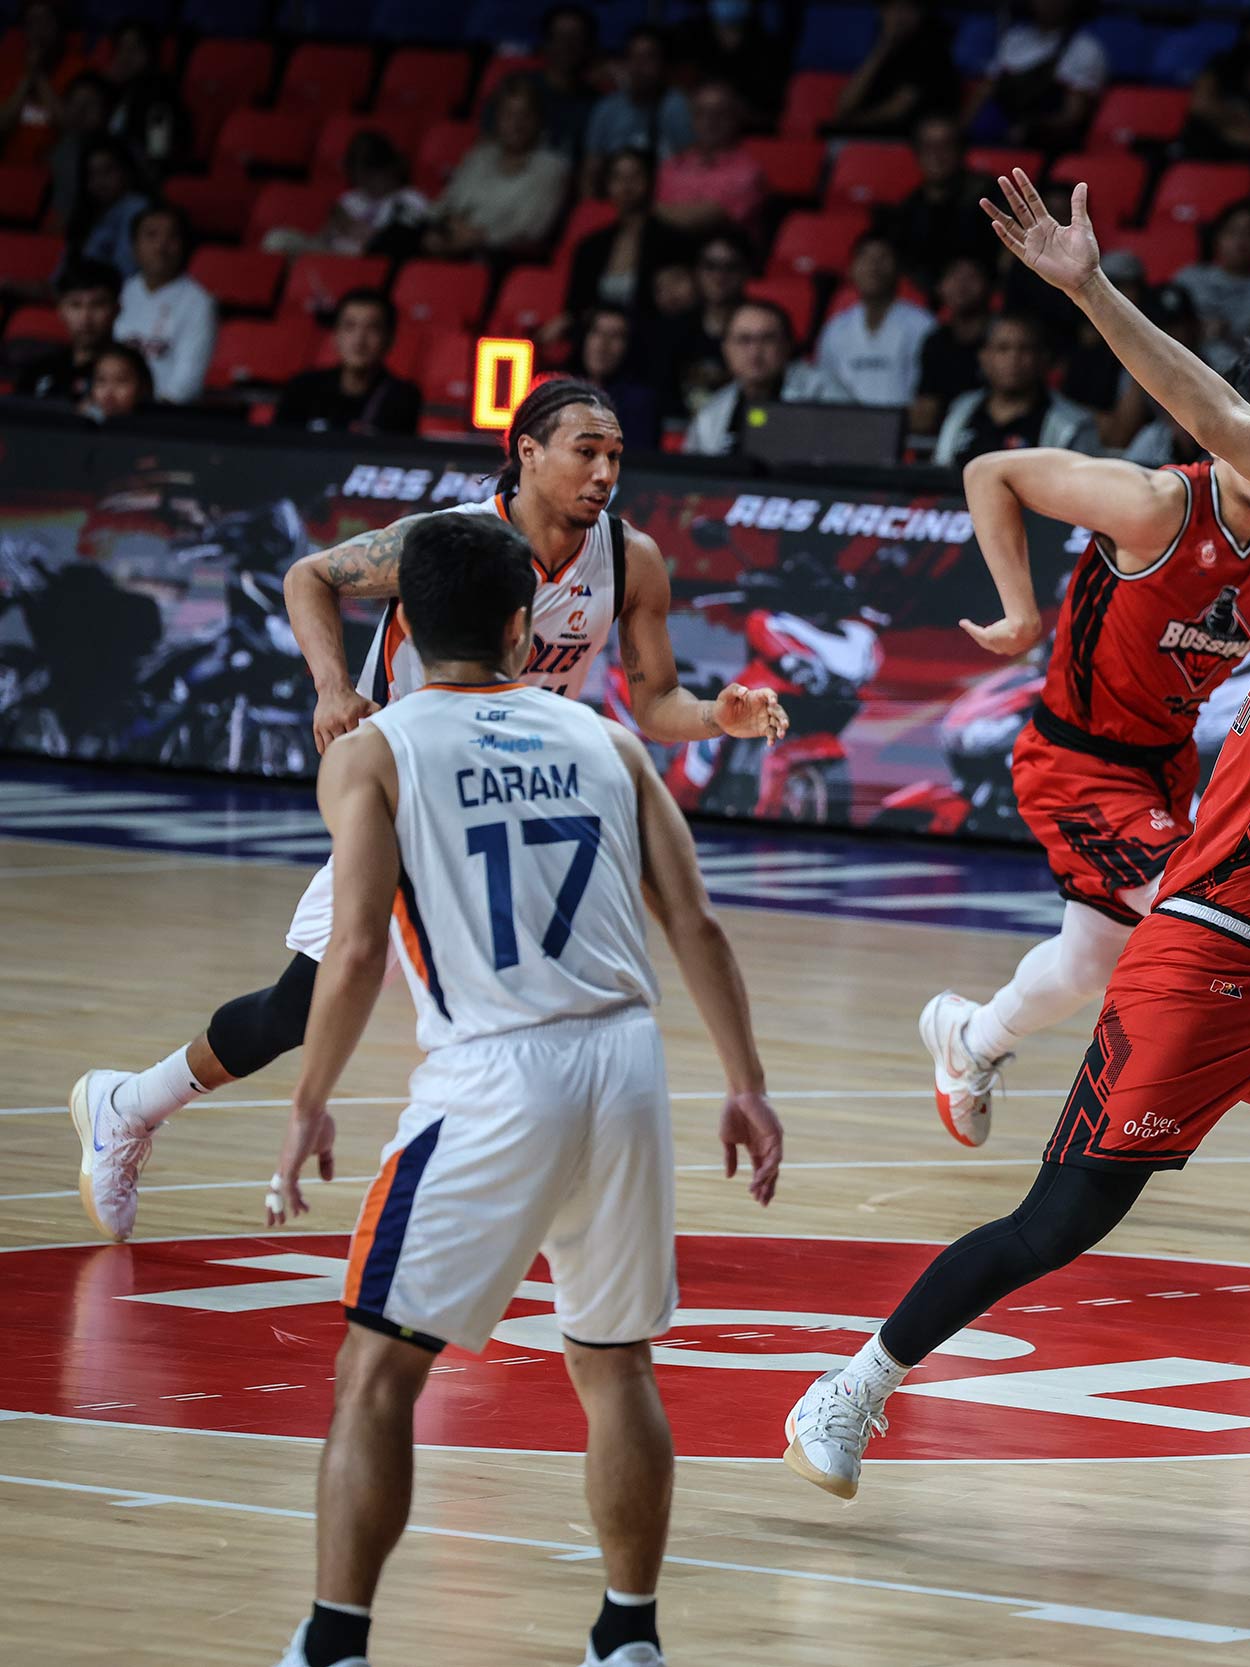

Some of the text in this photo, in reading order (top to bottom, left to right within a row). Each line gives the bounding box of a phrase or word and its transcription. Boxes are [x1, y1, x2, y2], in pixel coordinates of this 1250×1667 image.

[472, 337, 534, 429] 0
[570, 585, 592, 597] PBA
[456, 763, 579, 808] CARAM
[466, 816, 601, 971] 17
[1141, 1111, 1176, 1128] Ever
